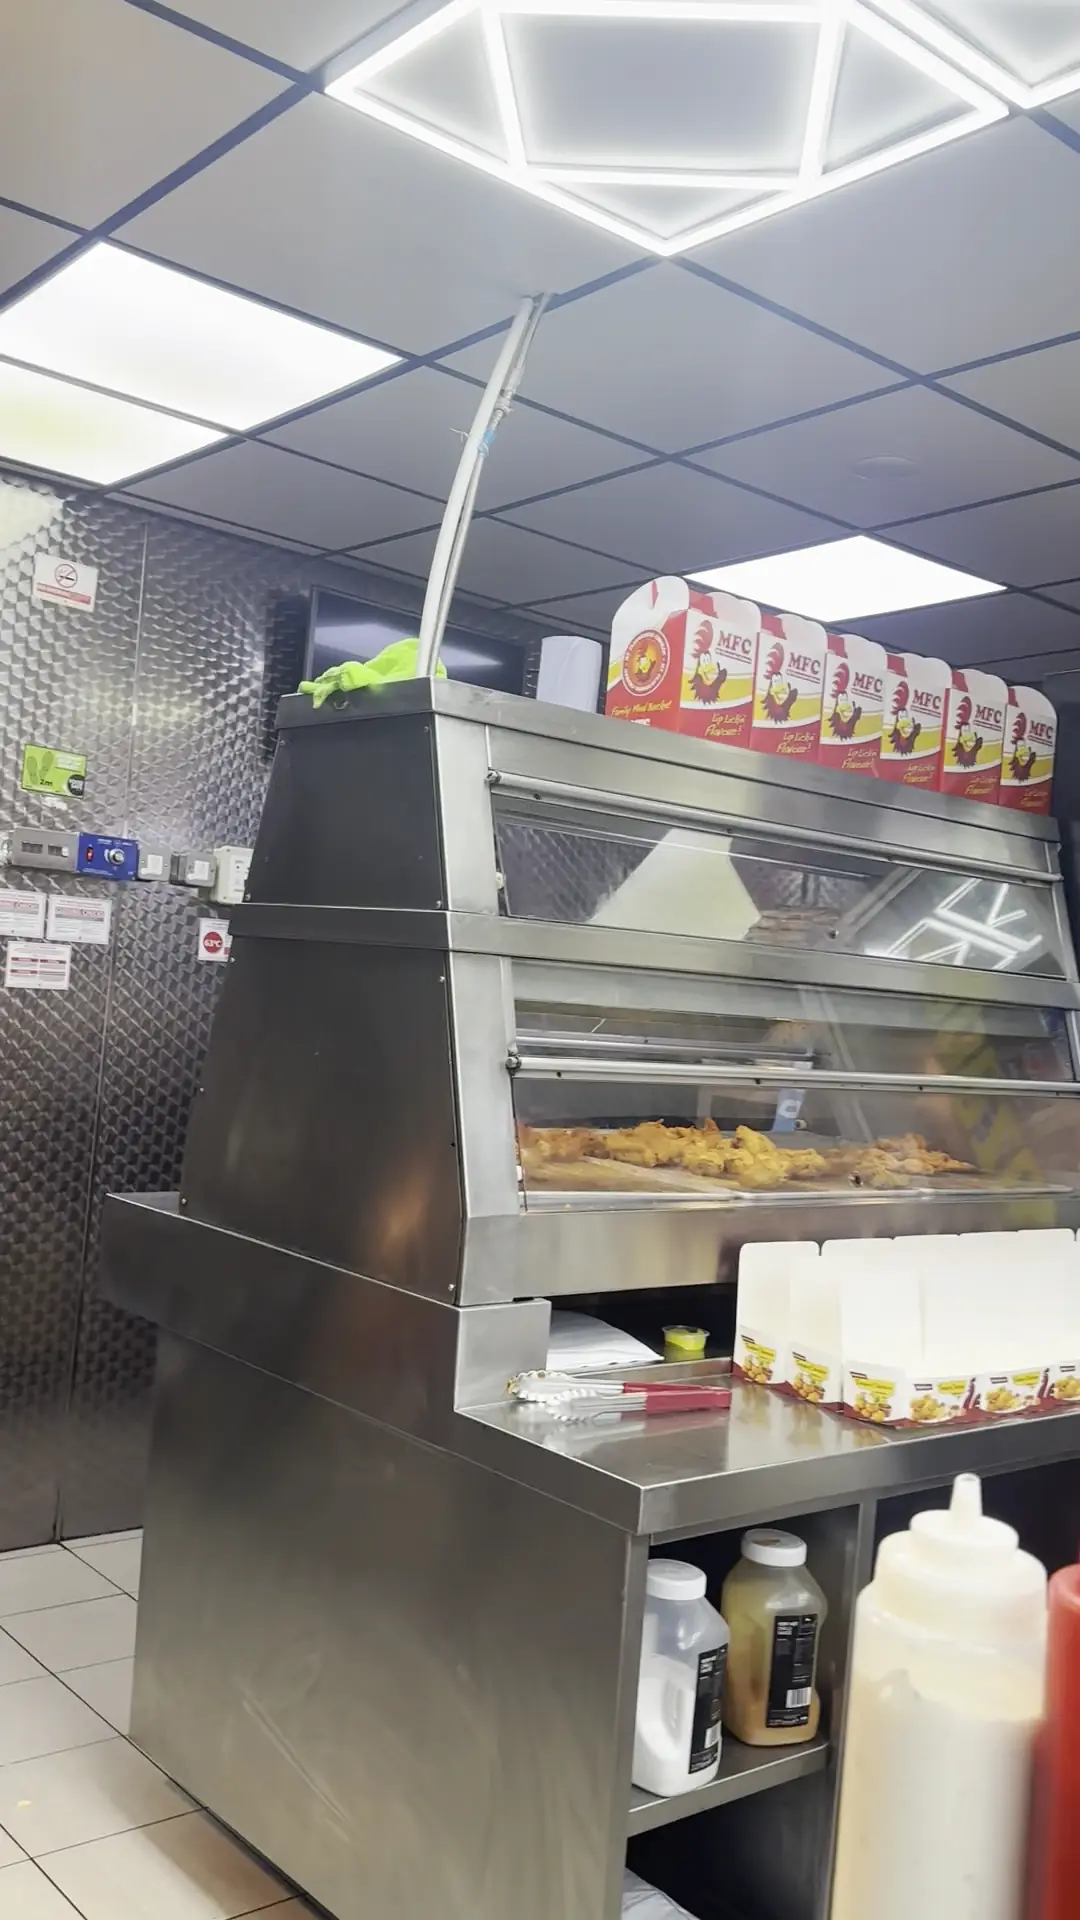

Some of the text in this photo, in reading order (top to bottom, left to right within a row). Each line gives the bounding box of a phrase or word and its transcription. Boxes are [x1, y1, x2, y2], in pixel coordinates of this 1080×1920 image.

[718, 630, 752, 655] MFC
[787, 652, 821, 675] MFC
[853, 672, 883, 693] MFC
[912, 689, 942, 710] MFC
[975, 704, 1002, 724] MFC
[1029, 720, 1054, 739] MFC
